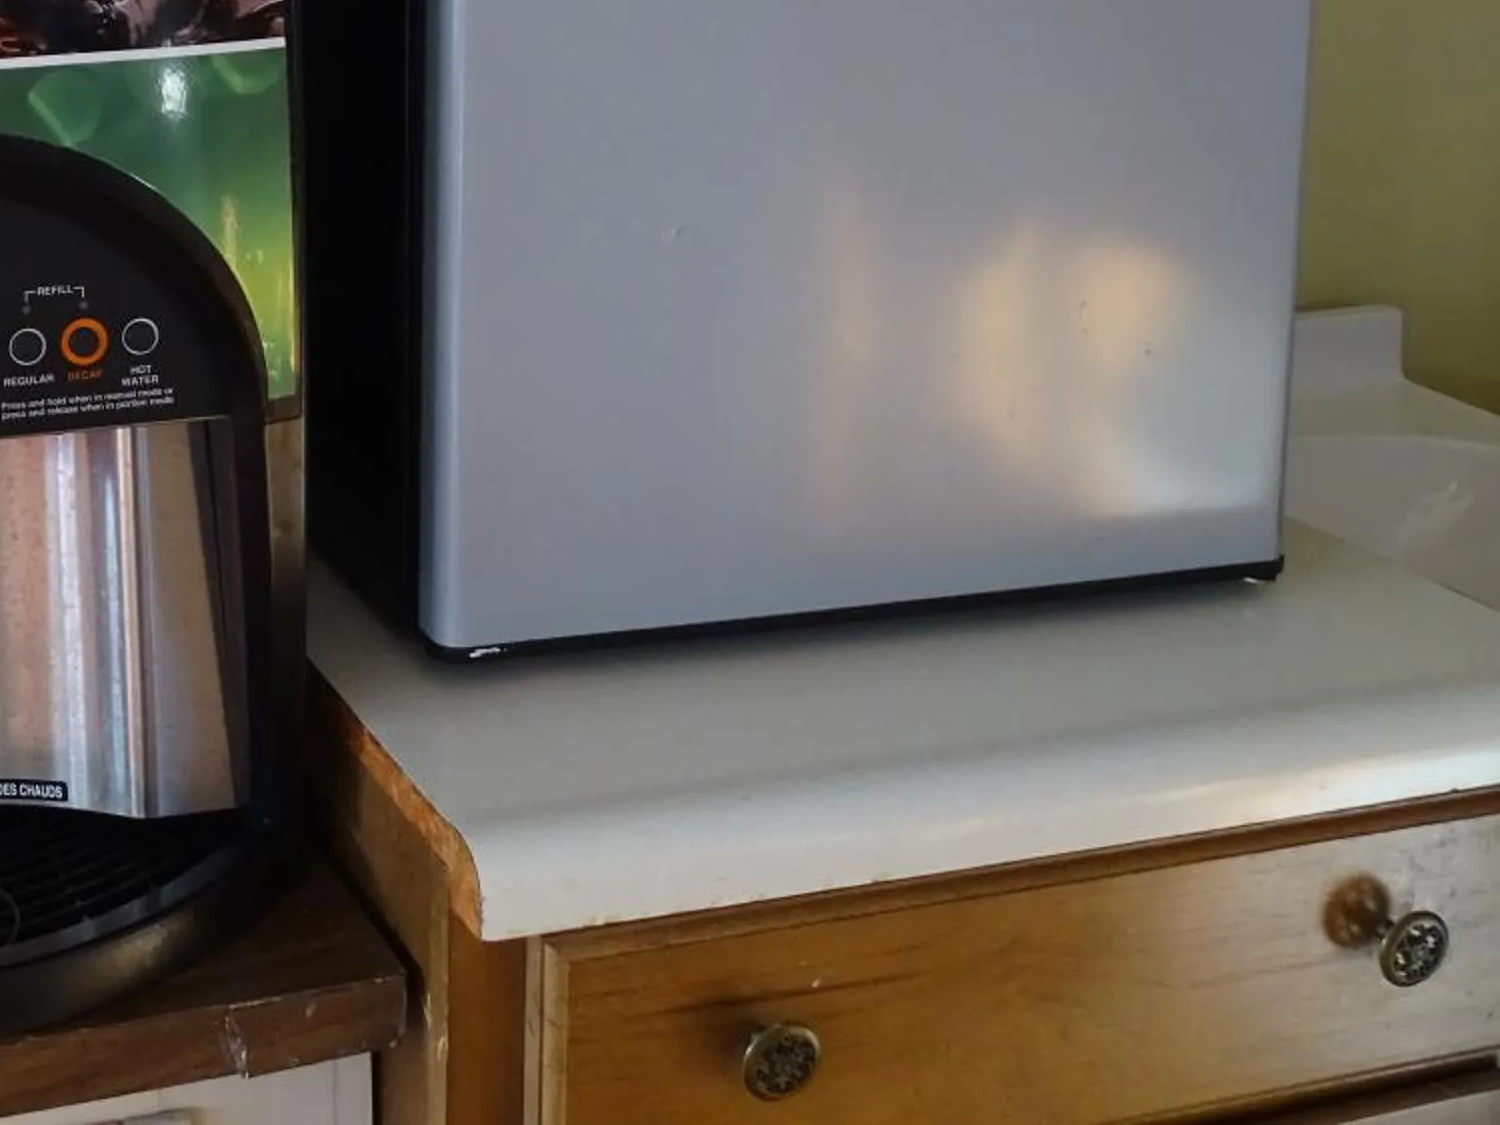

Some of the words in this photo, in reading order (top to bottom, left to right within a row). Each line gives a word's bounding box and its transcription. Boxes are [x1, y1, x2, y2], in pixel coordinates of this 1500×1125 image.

[37, 285, 74, 296] REFILL
[130, 364, 152, 375] HOT
[3, 372, 56, 388] REGULAR
[121, 374, 160, 387] WATER
[19, 782, 64, 799] CHAUDS
